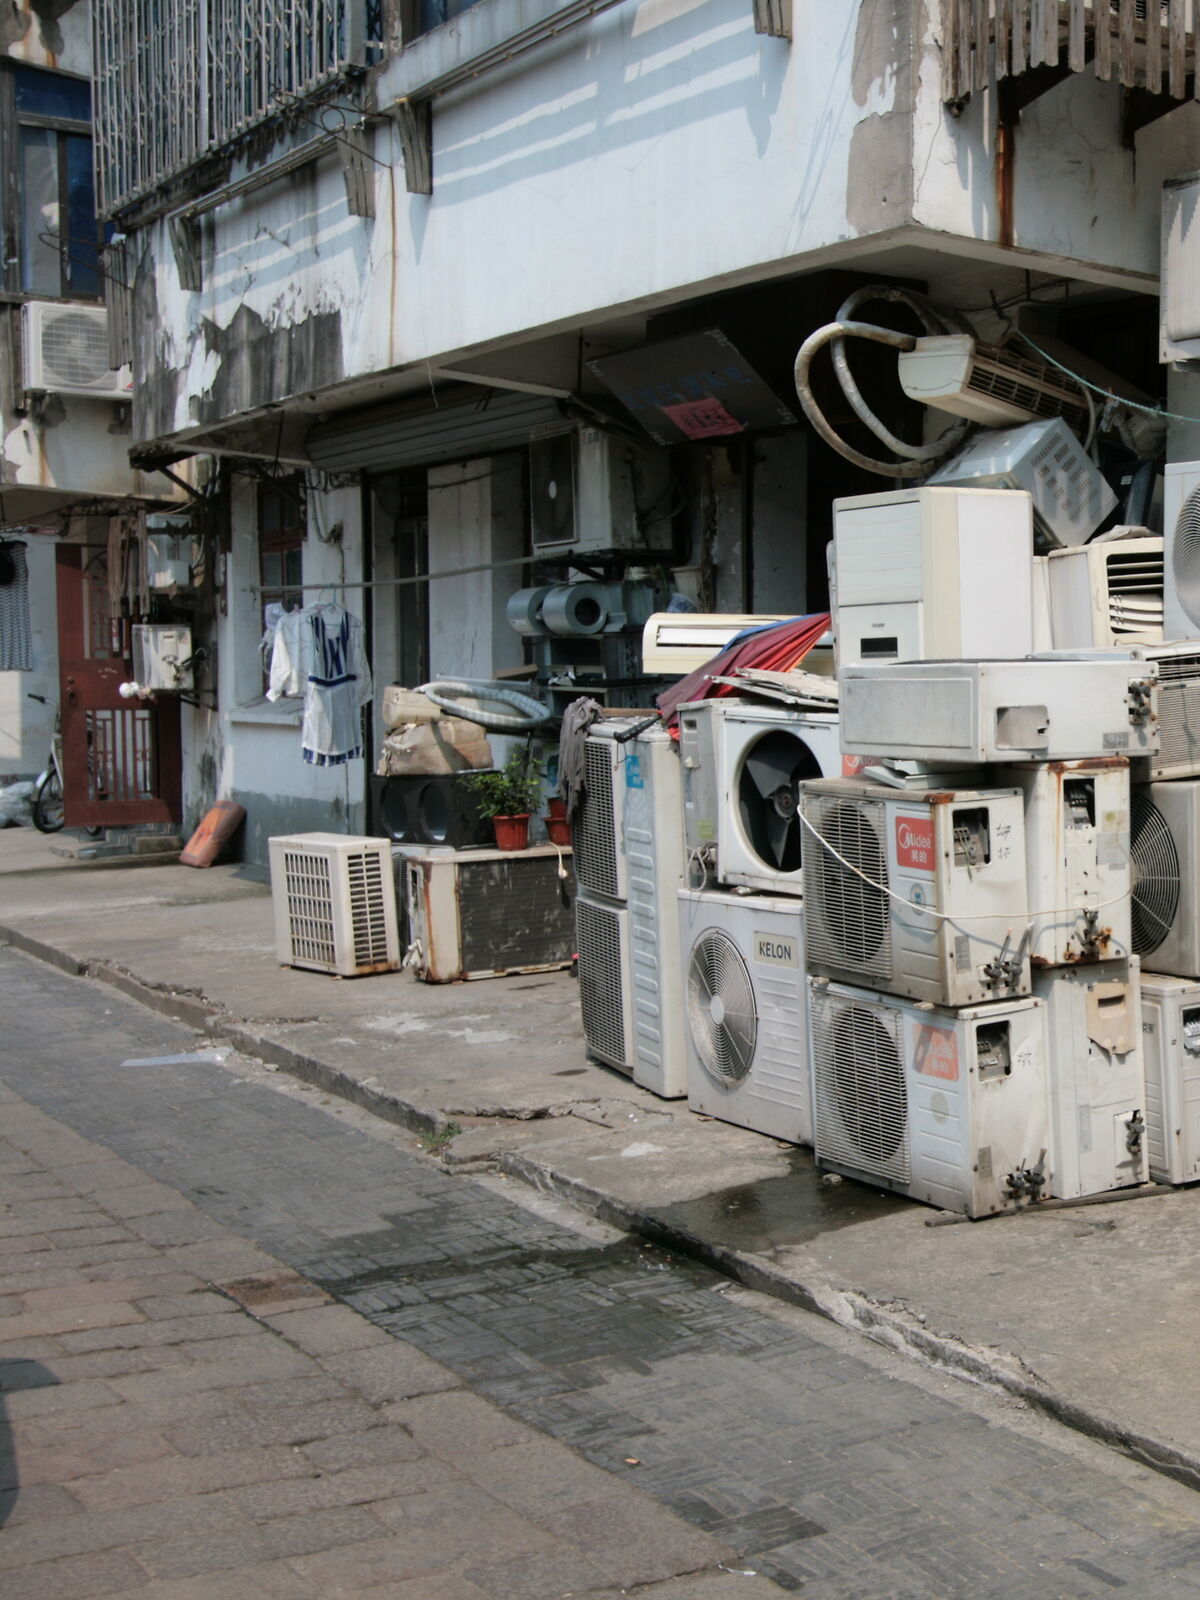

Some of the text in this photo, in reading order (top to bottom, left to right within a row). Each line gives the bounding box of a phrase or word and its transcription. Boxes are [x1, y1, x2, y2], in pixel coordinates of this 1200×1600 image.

[898, 823, 931, 848] Midea
[911, 850, 928, 864] 美的
[759, 941, 792, 961] KELON
